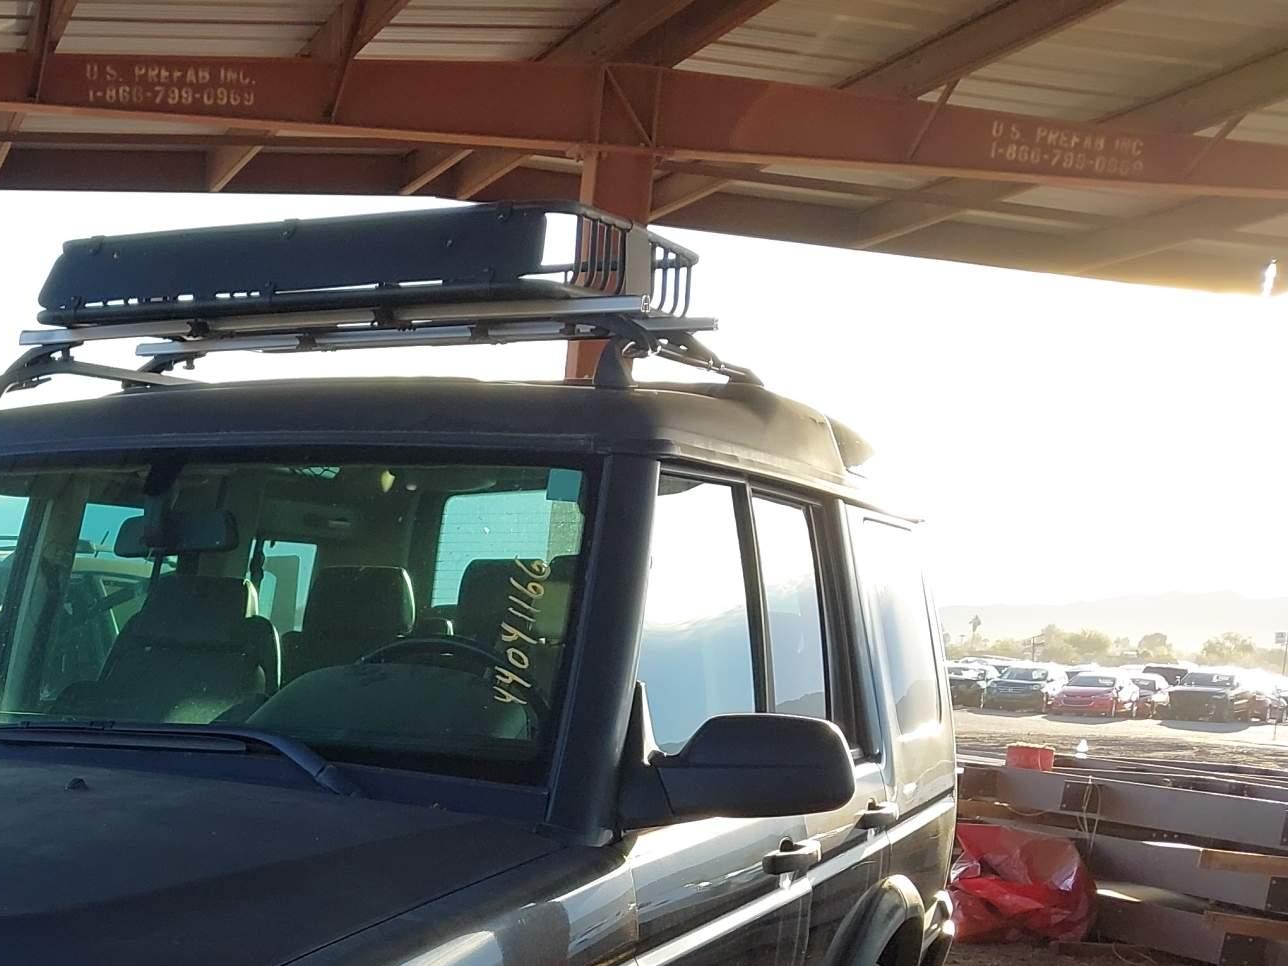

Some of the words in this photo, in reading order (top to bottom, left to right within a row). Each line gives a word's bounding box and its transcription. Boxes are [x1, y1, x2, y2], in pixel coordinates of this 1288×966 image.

[134, 64, 210, 84] PREFAB
[219, 65, 256, 85] INC.
[1035, 126, 1105, 151] PREFAB
[493, 555, 551, 705] 44041166
